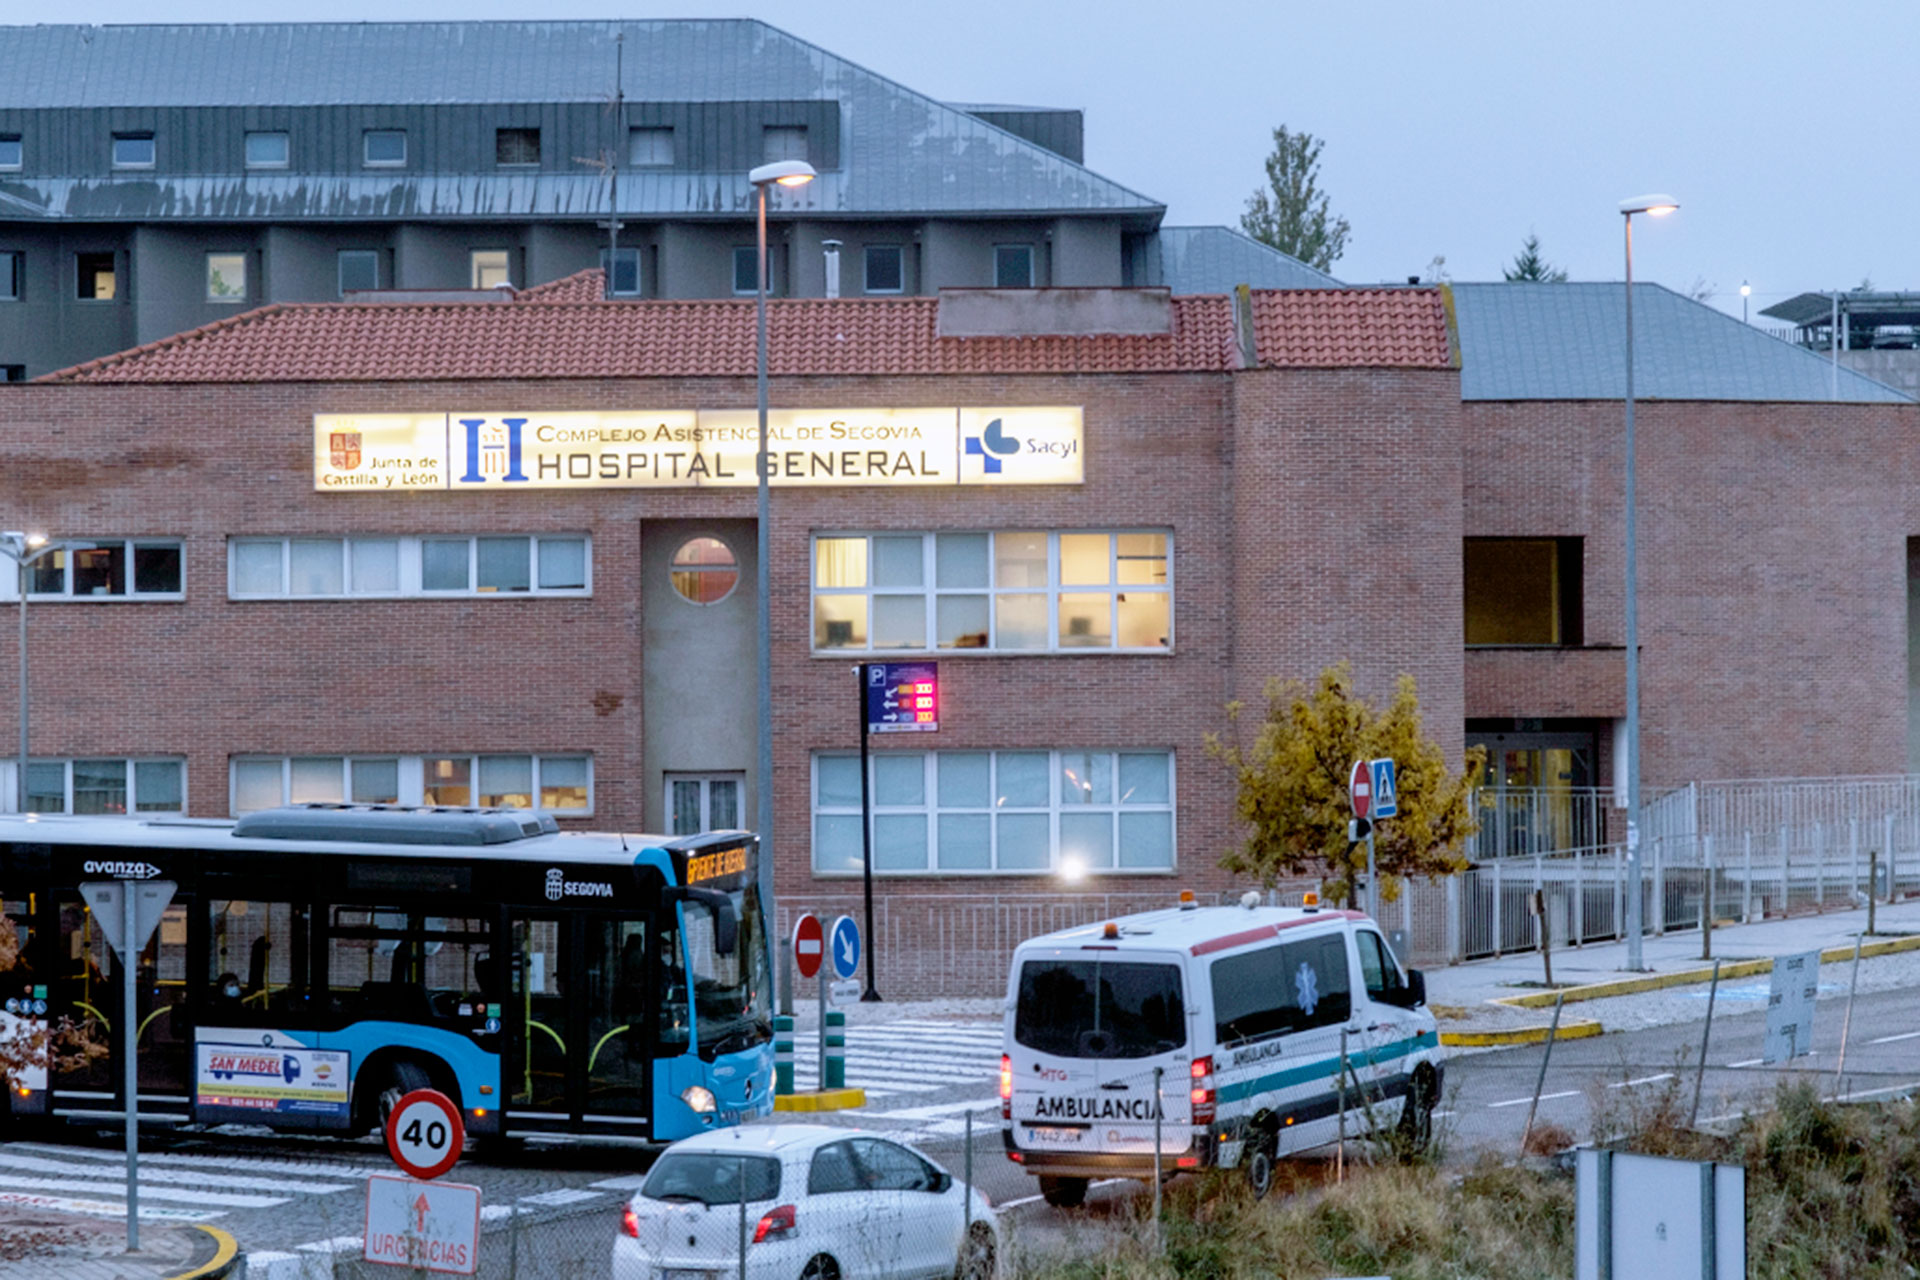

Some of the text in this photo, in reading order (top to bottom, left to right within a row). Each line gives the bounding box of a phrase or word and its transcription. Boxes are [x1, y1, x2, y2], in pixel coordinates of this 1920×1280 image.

[653, 422, 792, 442] ASISTENCAL
[1026, 437, 1077, 458] Sacyl
[368, 456, 438, 469] Junta de
[537, 451, 939, 479] HOSPITAL GENERAL
[323, 471, 438, 487] Castilla y León
[870, 668, 883, 683] P
[84, 861, 145, 874] avanza
[564, 882, 613, 897] SEGOVIA
[209, 1056, 281, 1074] SAN MEDEL
[1035, 1096, 1165, 1121] AMBULANCIA
[402, 1118, 447, 1150] 40
[371, 1233, 468, 1267] URGENCIAS
